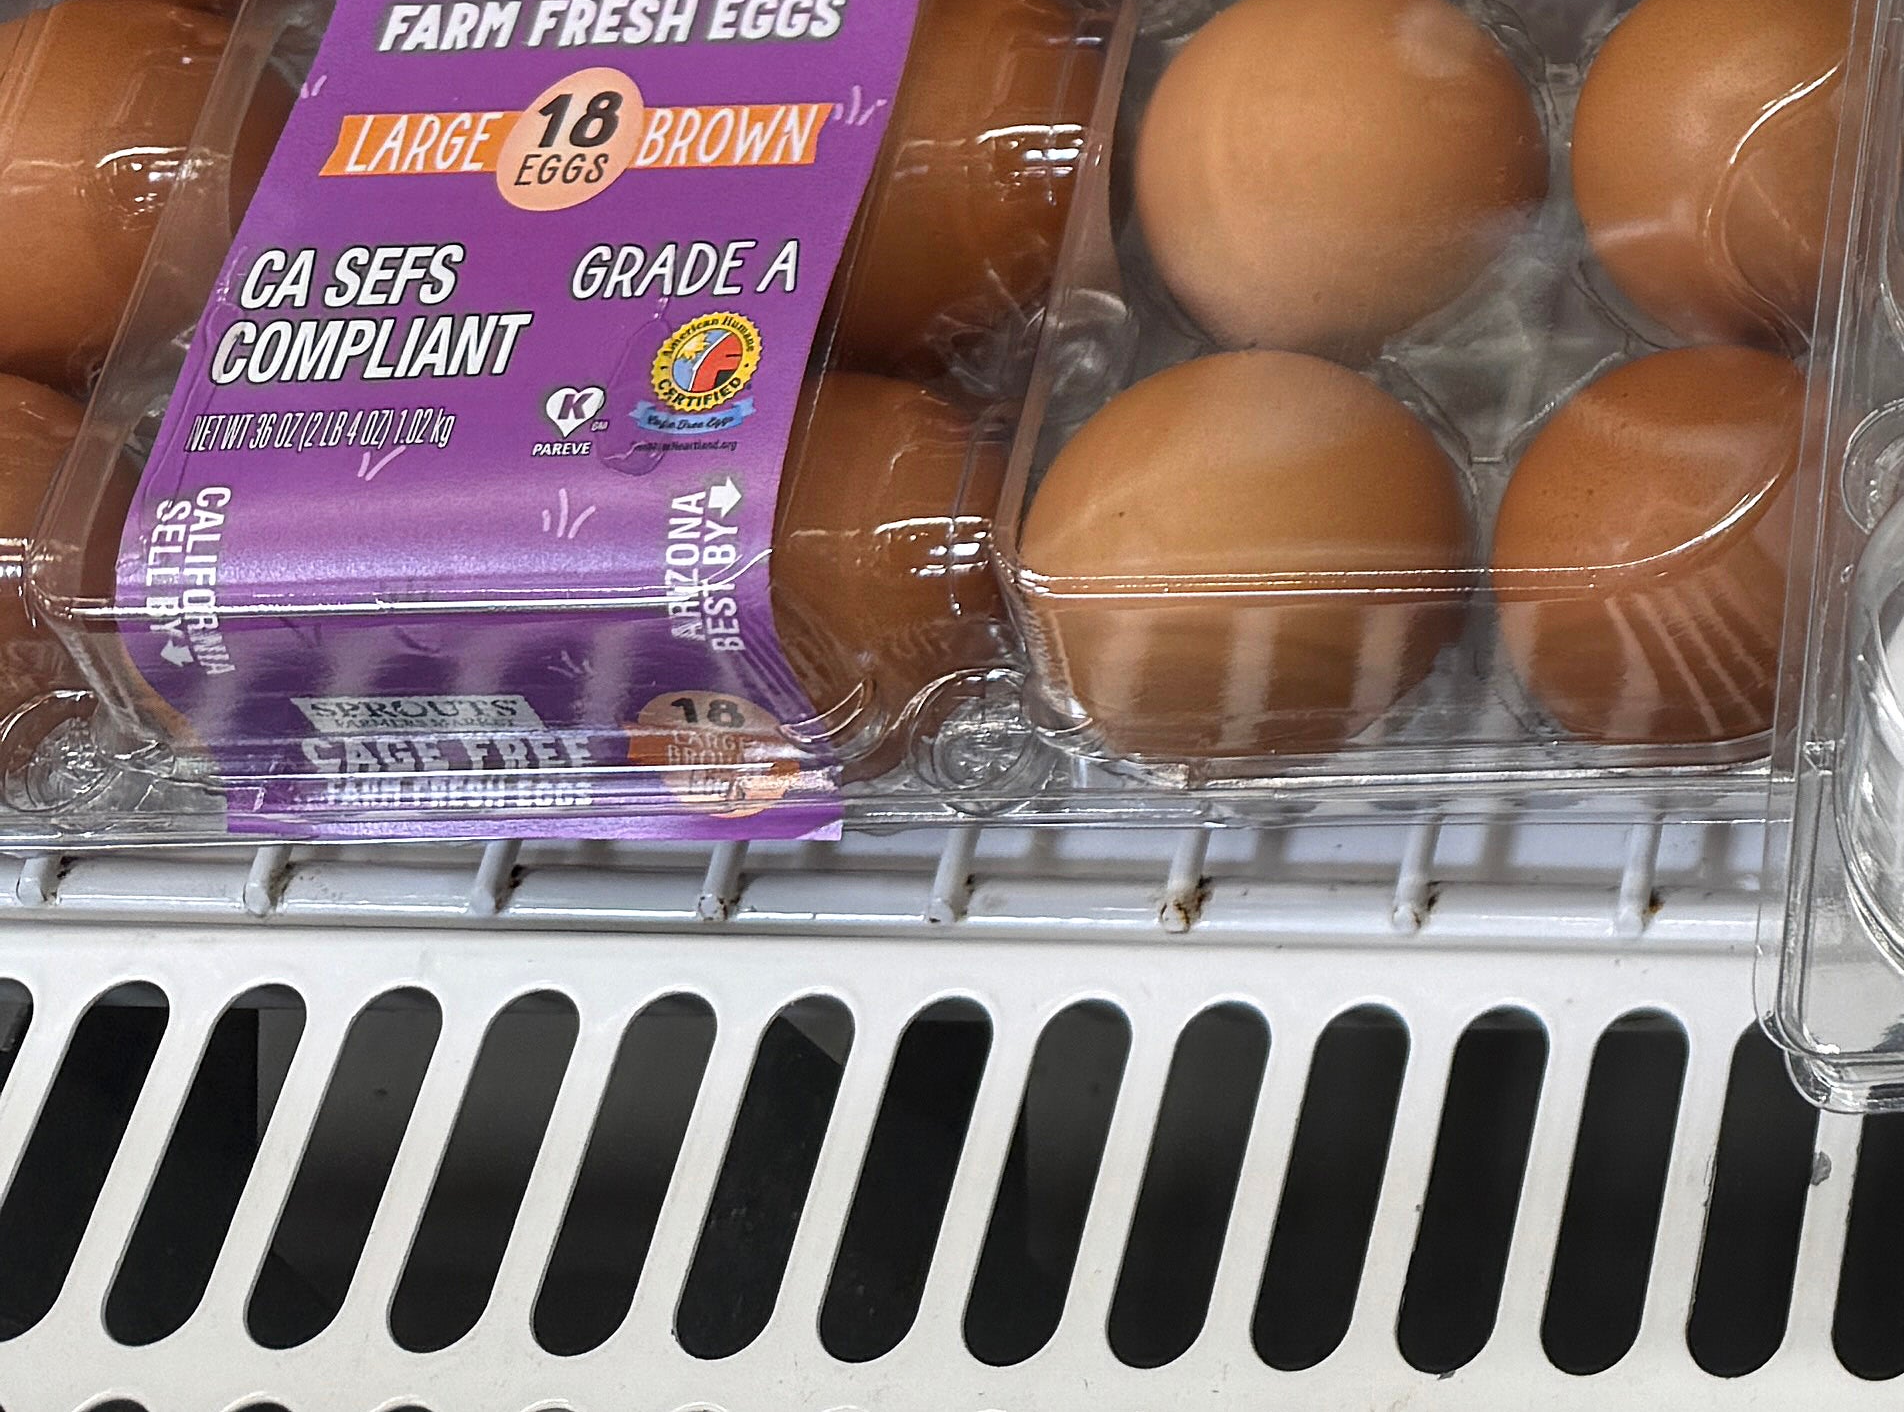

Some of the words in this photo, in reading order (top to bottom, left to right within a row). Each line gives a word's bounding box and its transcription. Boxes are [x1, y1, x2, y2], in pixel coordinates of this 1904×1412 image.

[378, 1, 522, 52] FARM
[345, 113, 504, 173] LARGE
[536, 93, 623, 147] 18
[634, 106, 820, 166] BROWN
[512, 155, 609, 188] EGGS
[241, 247, 319, 311] CA
[326, 244, 465, 307] SEFS
[572, 239, 756, 299] GRADE
[758, 239, 800, 293] A
[210, 313, 533, 386] COMPLIANT
[532, 442, 591, 457] PAREVE
